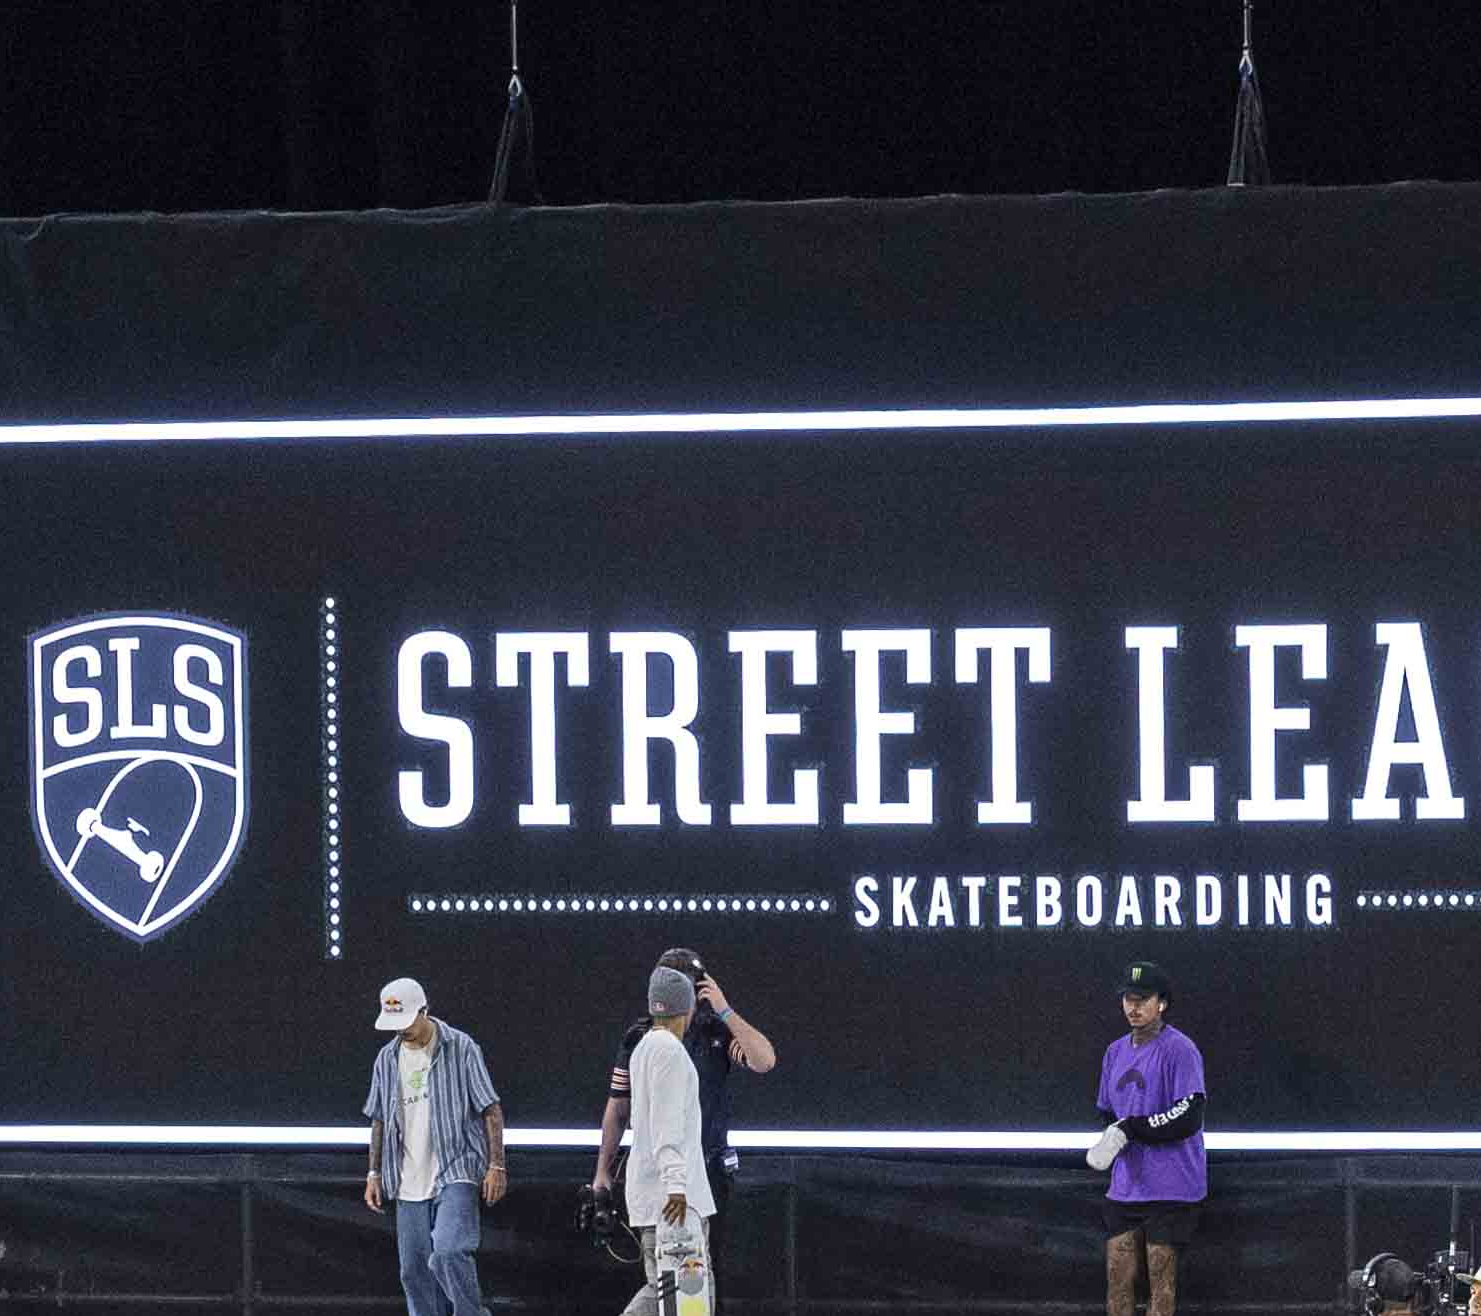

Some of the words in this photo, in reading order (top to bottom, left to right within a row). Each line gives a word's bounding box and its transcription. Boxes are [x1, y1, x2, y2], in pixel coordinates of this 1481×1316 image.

[52, 636, 225, 748] SLS
[397, 628, 1050, 828] STREET
[854, 874, 1335, 928] SKATEBOARDING
